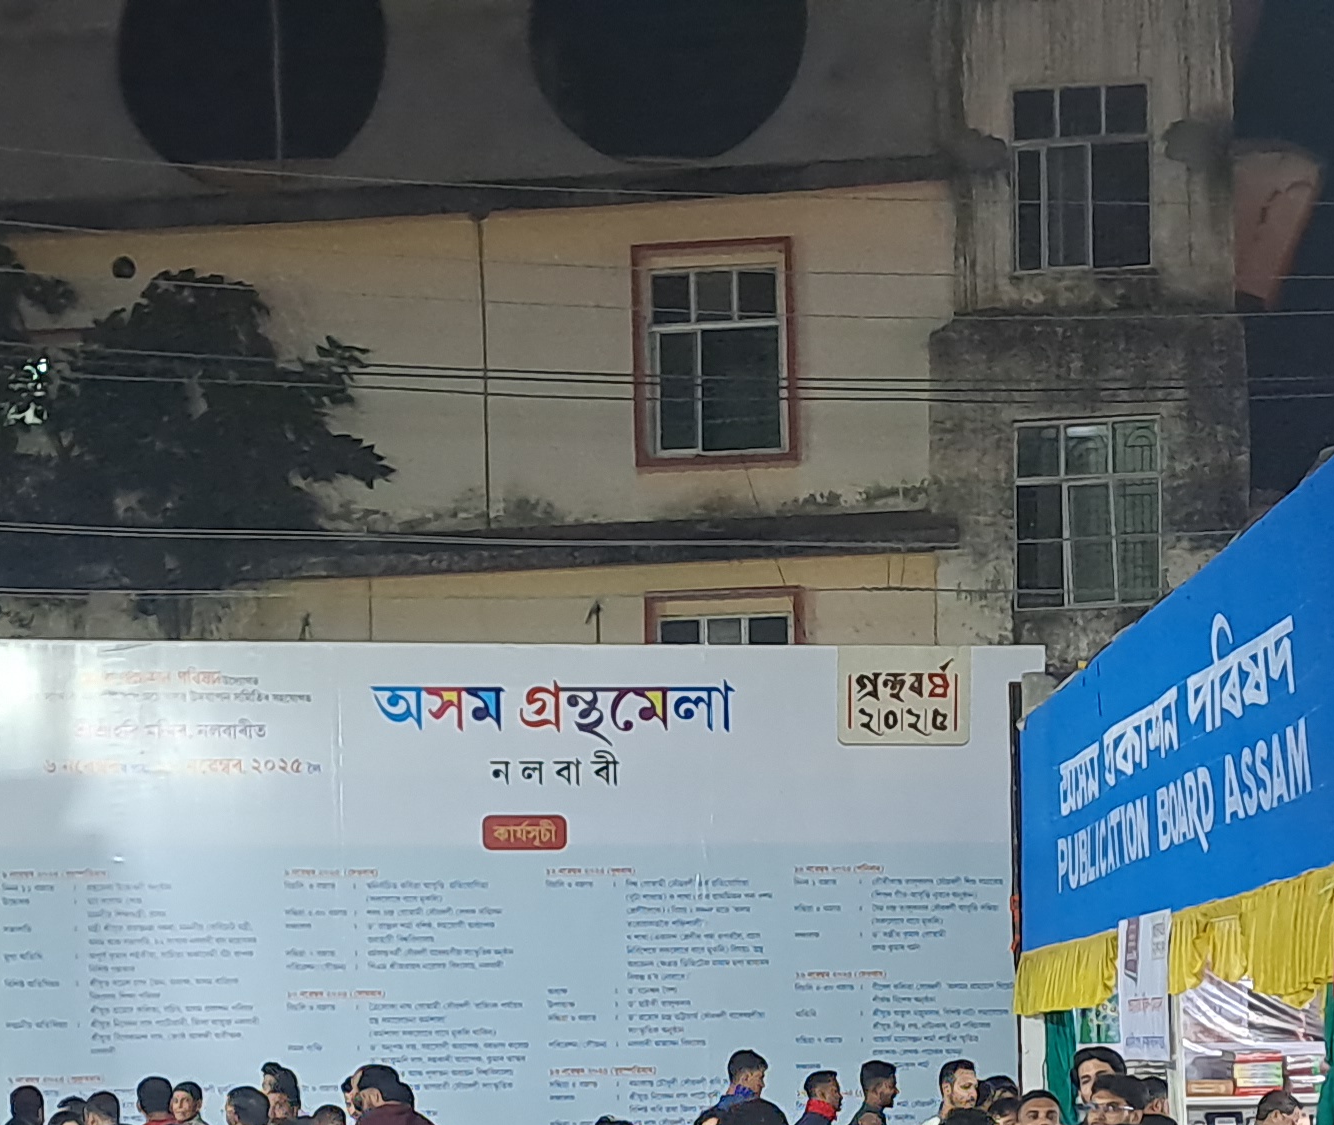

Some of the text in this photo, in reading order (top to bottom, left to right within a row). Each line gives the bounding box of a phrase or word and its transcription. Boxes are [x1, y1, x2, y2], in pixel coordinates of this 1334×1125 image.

[370, 685, 505, 731] অসম
[1186, 613, 1295, 733] পৰিষদ
[252, 758, 302, 774] ২০২৫
[1057, 716, 1312, 893] PUBLICATION BOARD ASSAM
